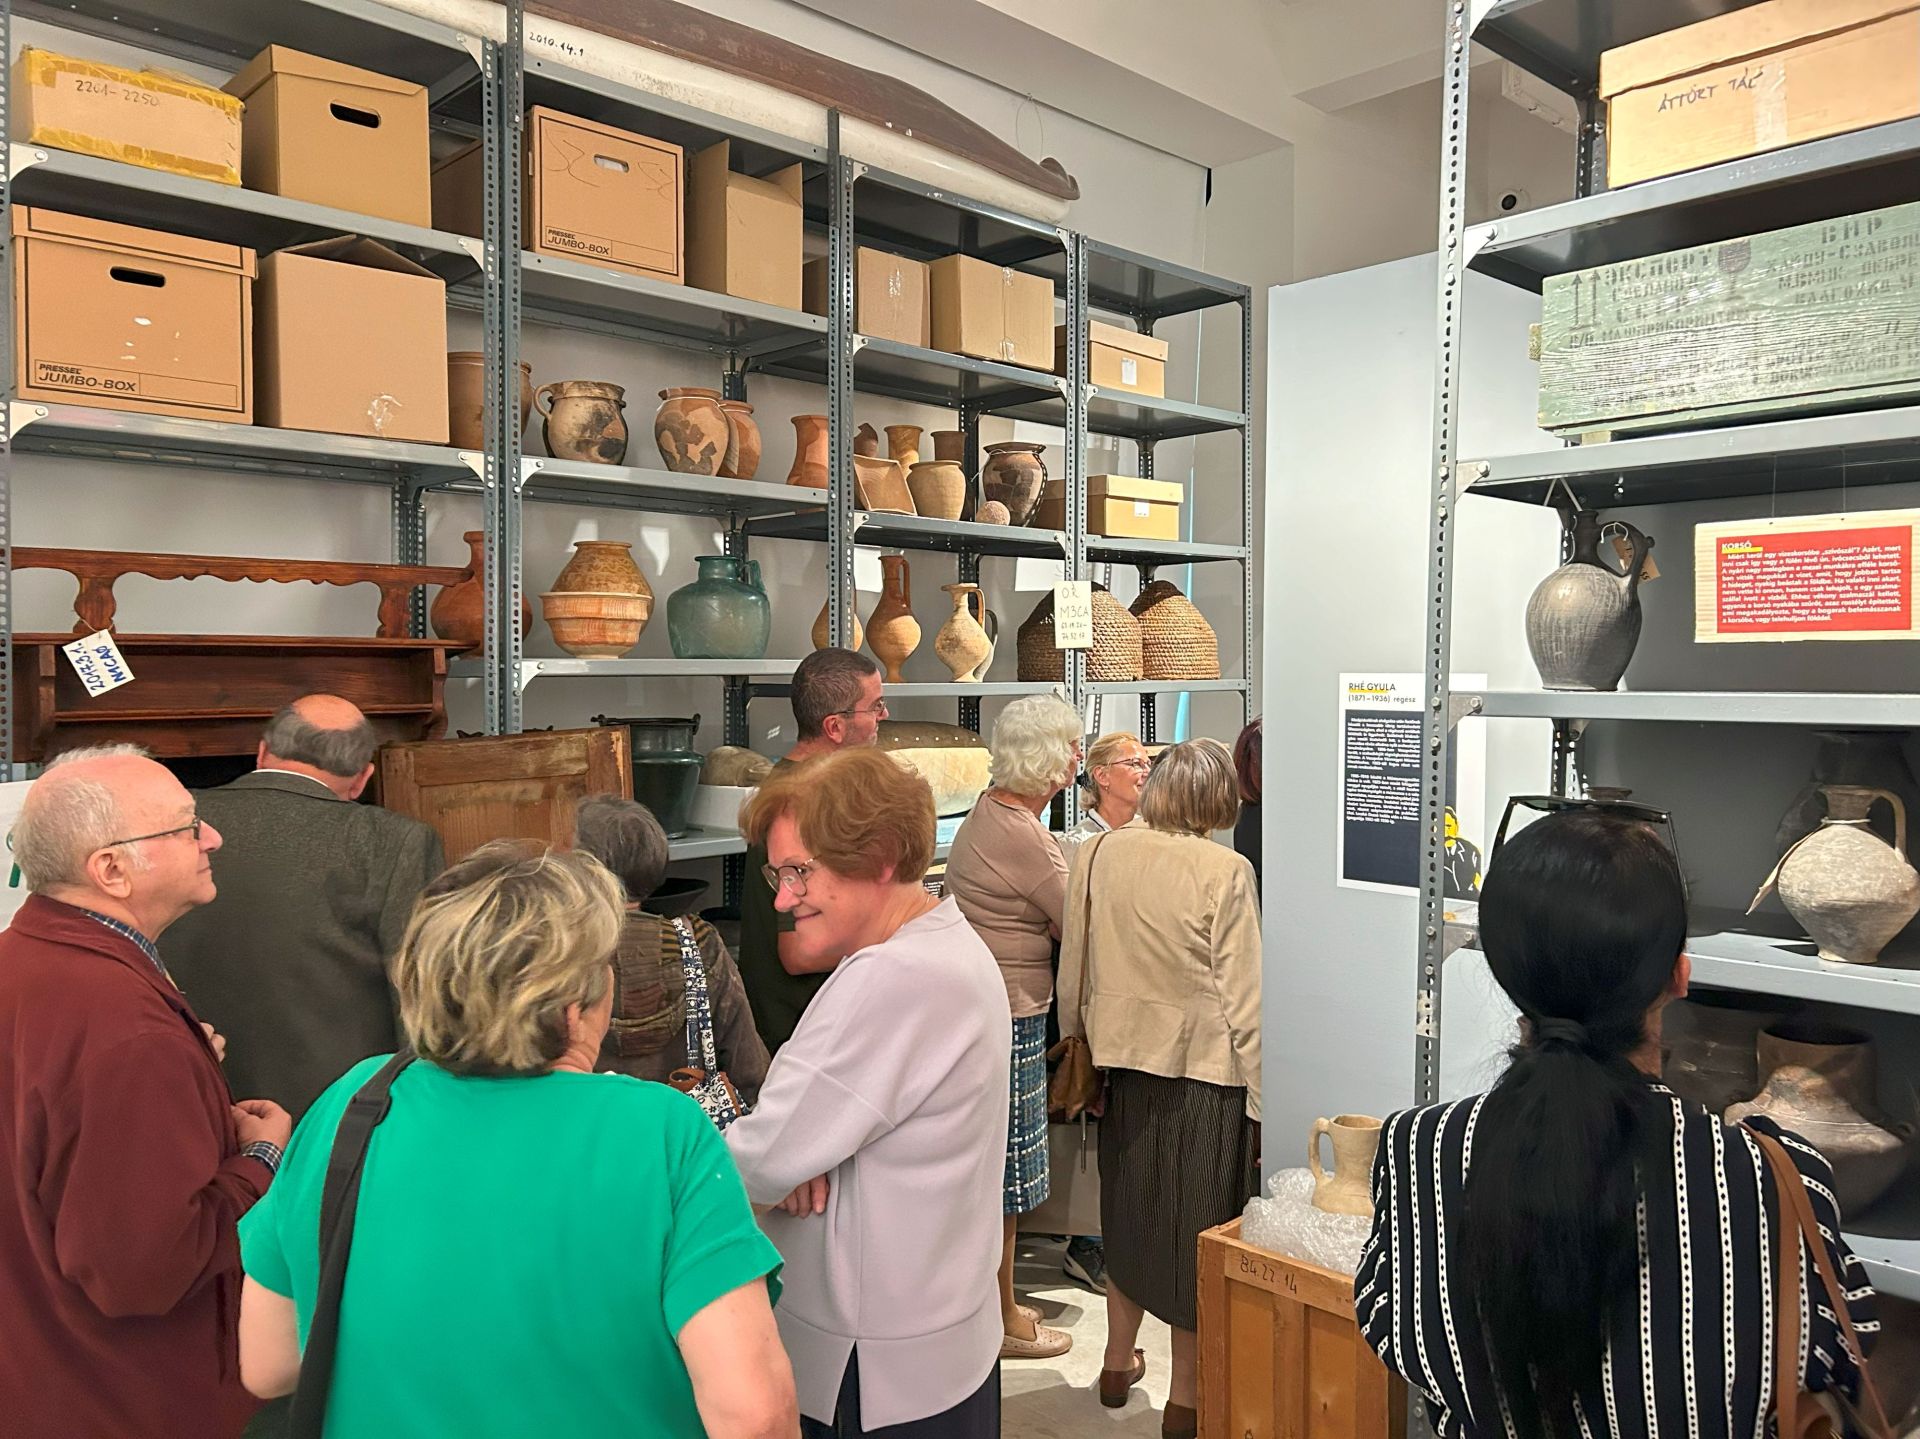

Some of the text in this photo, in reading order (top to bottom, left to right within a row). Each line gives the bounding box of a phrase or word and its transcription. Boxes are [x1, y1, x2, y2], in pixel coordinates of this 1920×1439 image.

[547, 236, 610, 255] JUMBO-BOX
[39, 363, 81, 375] PRESSEL
[38, 371, 136, 392] JUMBO-BOX
[1721, 540, 1752, 550] KORSÓ
[1348, 680, 1396, 691] RHÉ GYULA
